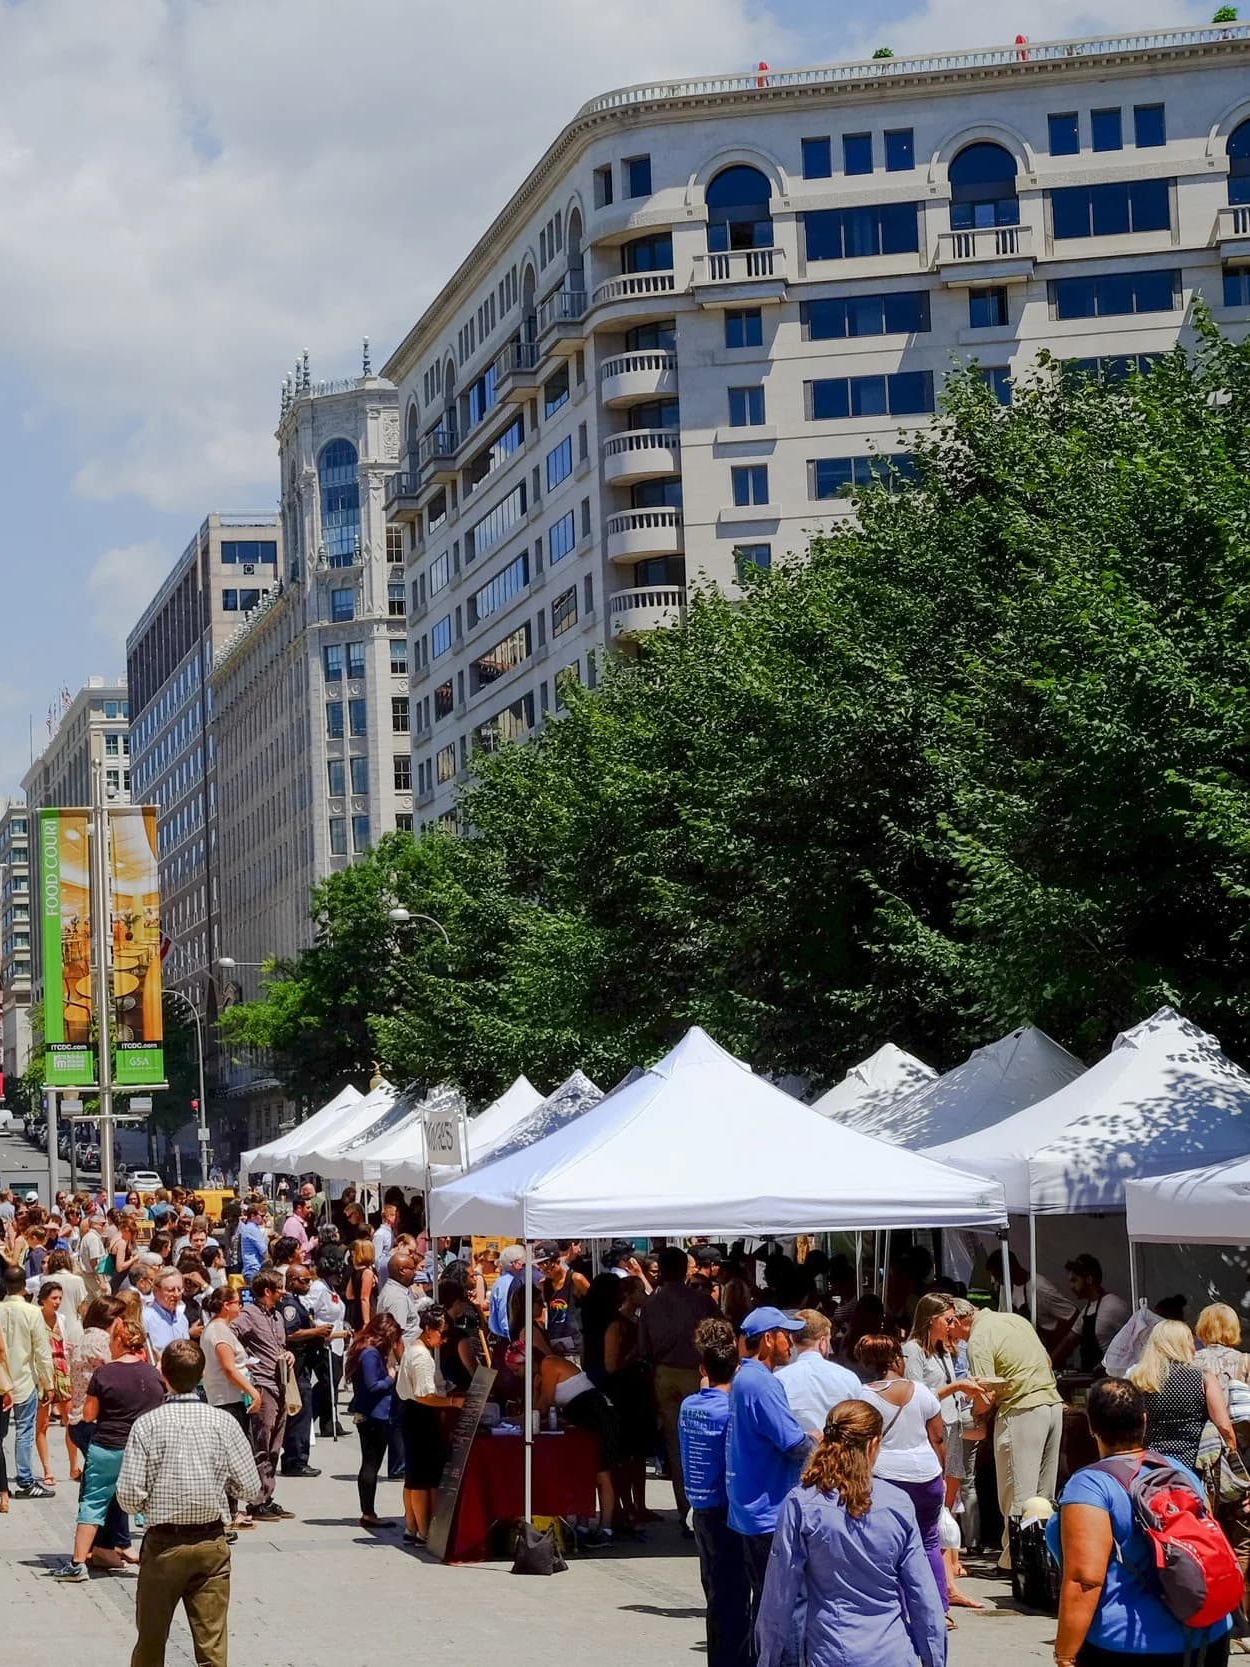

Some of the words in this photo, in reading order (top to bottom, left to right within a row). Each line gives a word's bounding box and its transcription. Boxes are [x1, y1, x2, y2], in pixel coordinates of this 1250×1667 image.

[45, 819, 58, 869] COURT
[46, 874, 59, 916] FOOD
[121, 1042, 158, 1050] ITCDC.com
[129, 1057, 150, 1067] GSA
